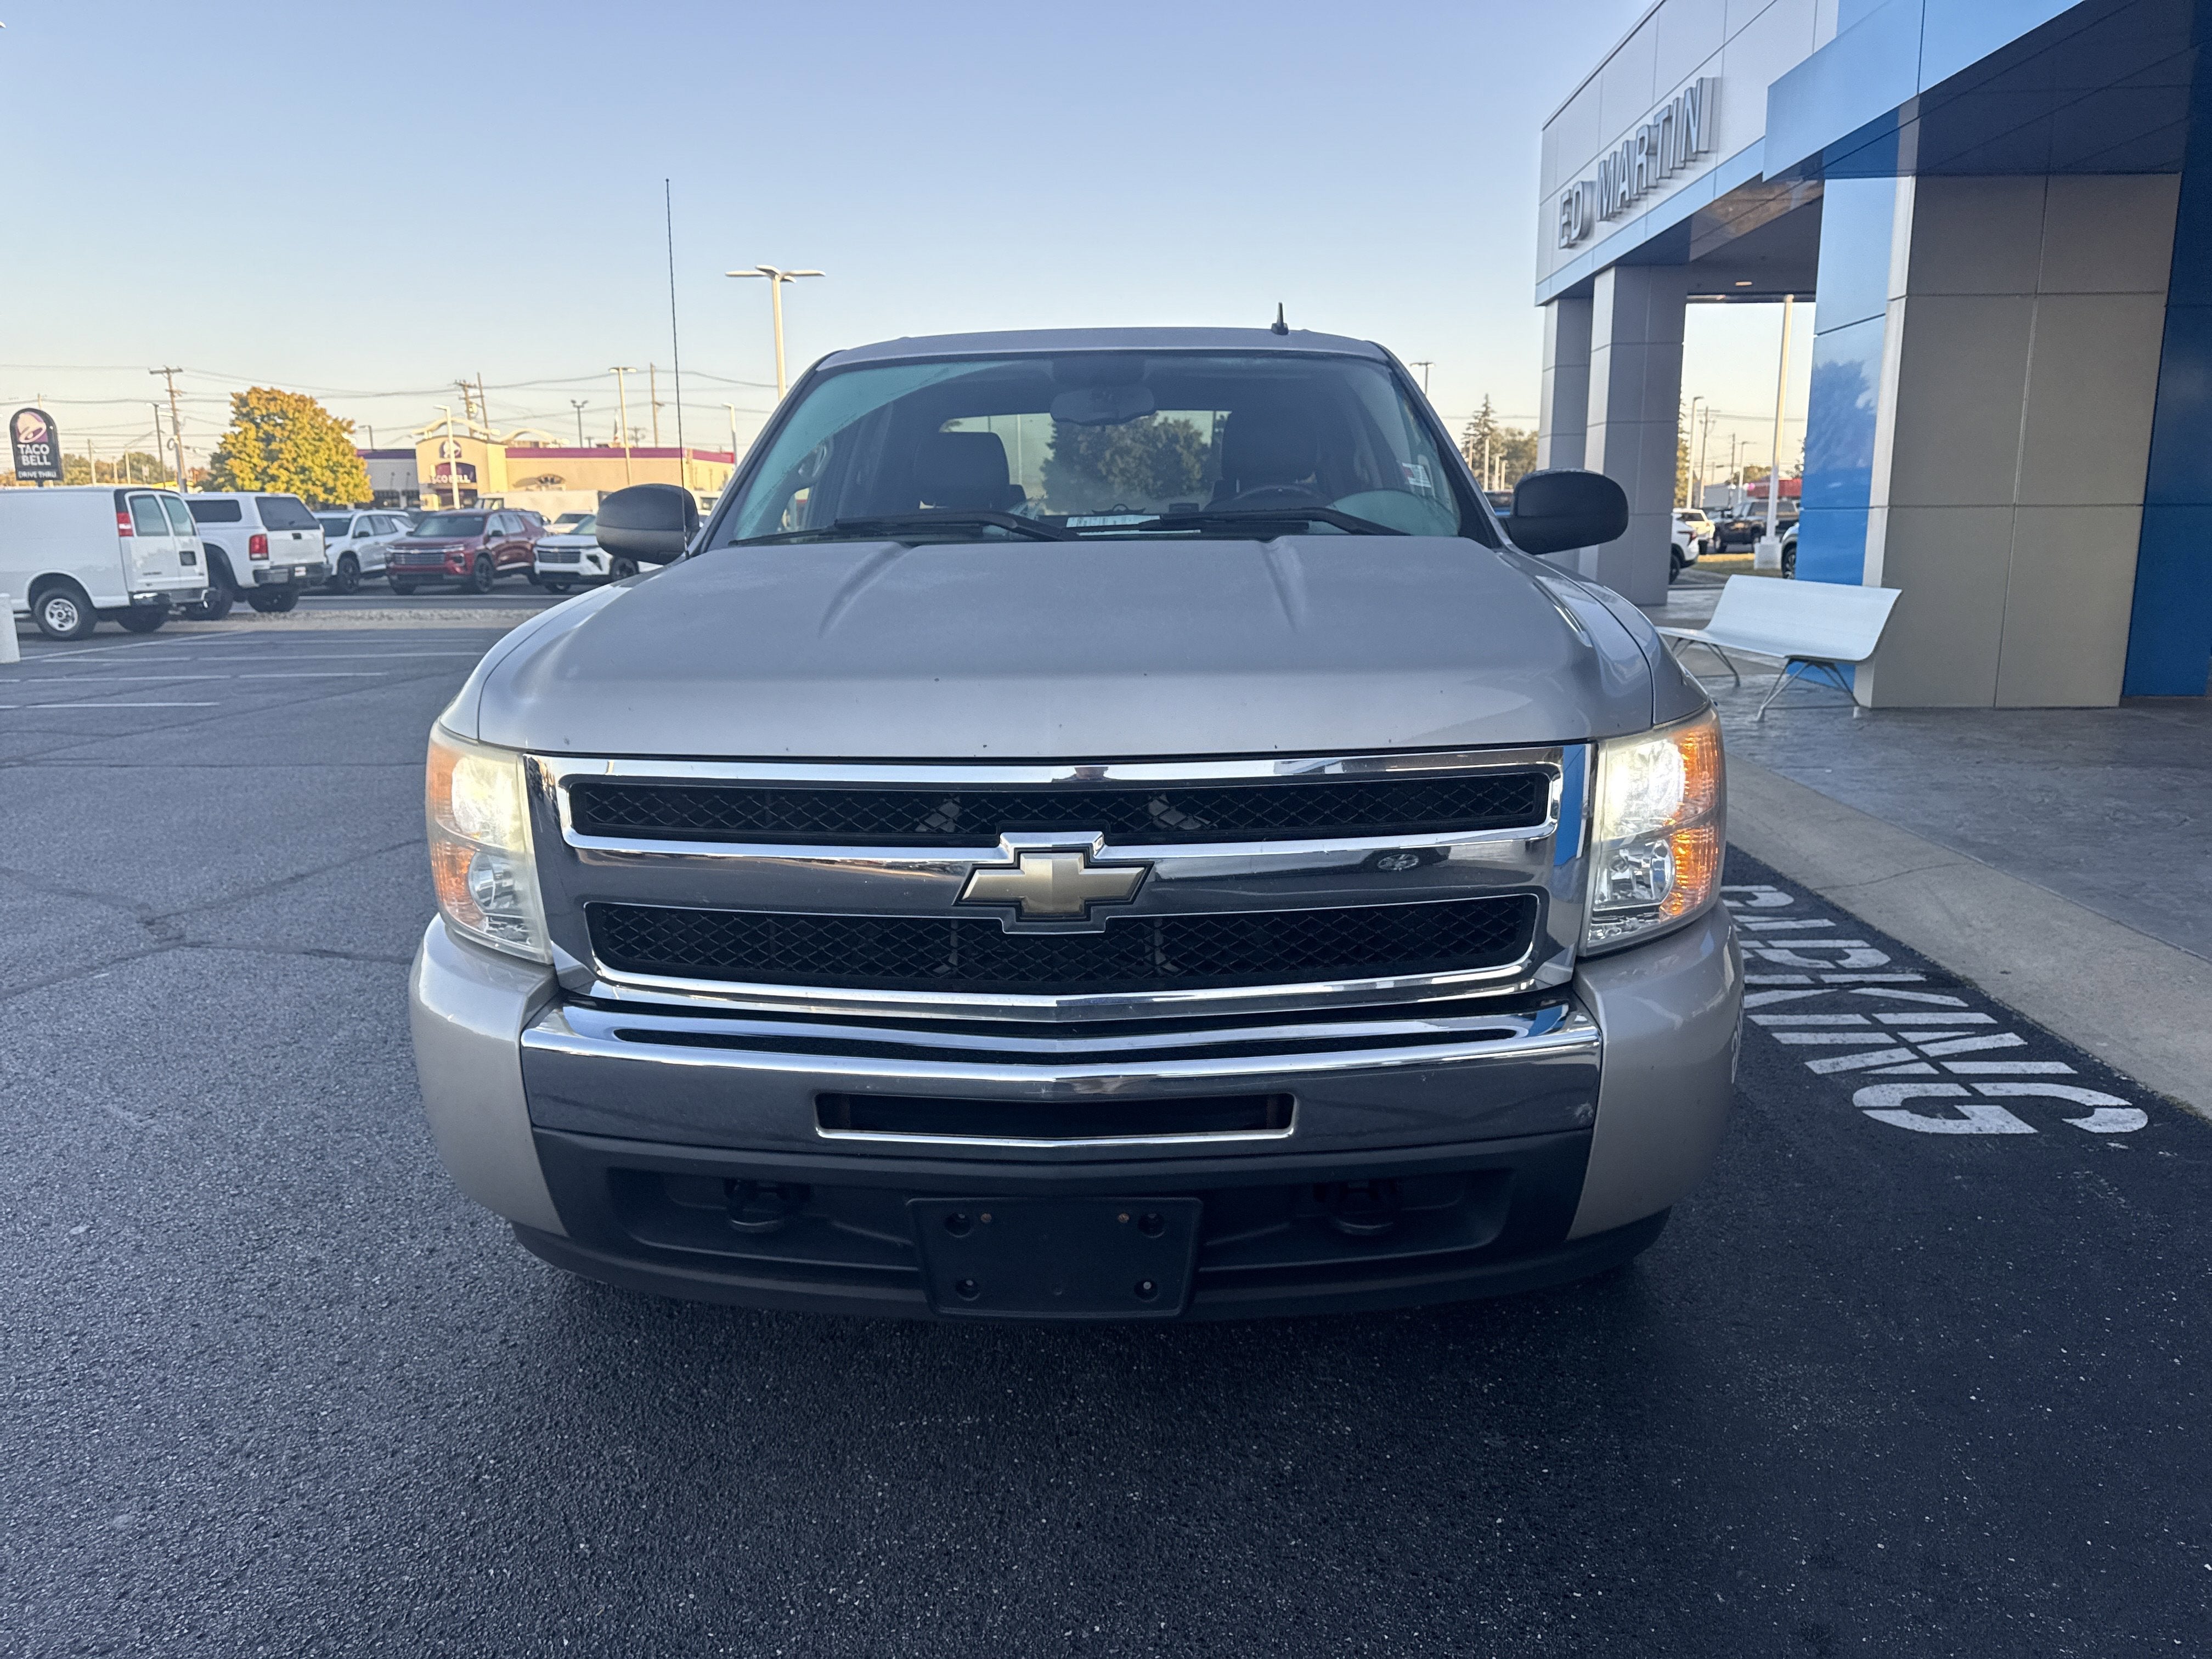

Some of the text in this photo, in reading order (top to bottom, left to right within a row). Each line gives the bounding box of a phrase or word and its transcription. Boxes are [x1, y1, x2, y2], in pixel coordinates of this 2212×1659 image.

[1559, 77, 1712, 249] ED MARTIN
[17, 444, 50, 455] TACO
[21, 455, 52, 466] BELL
[430, 475, 448, 484] ACO
